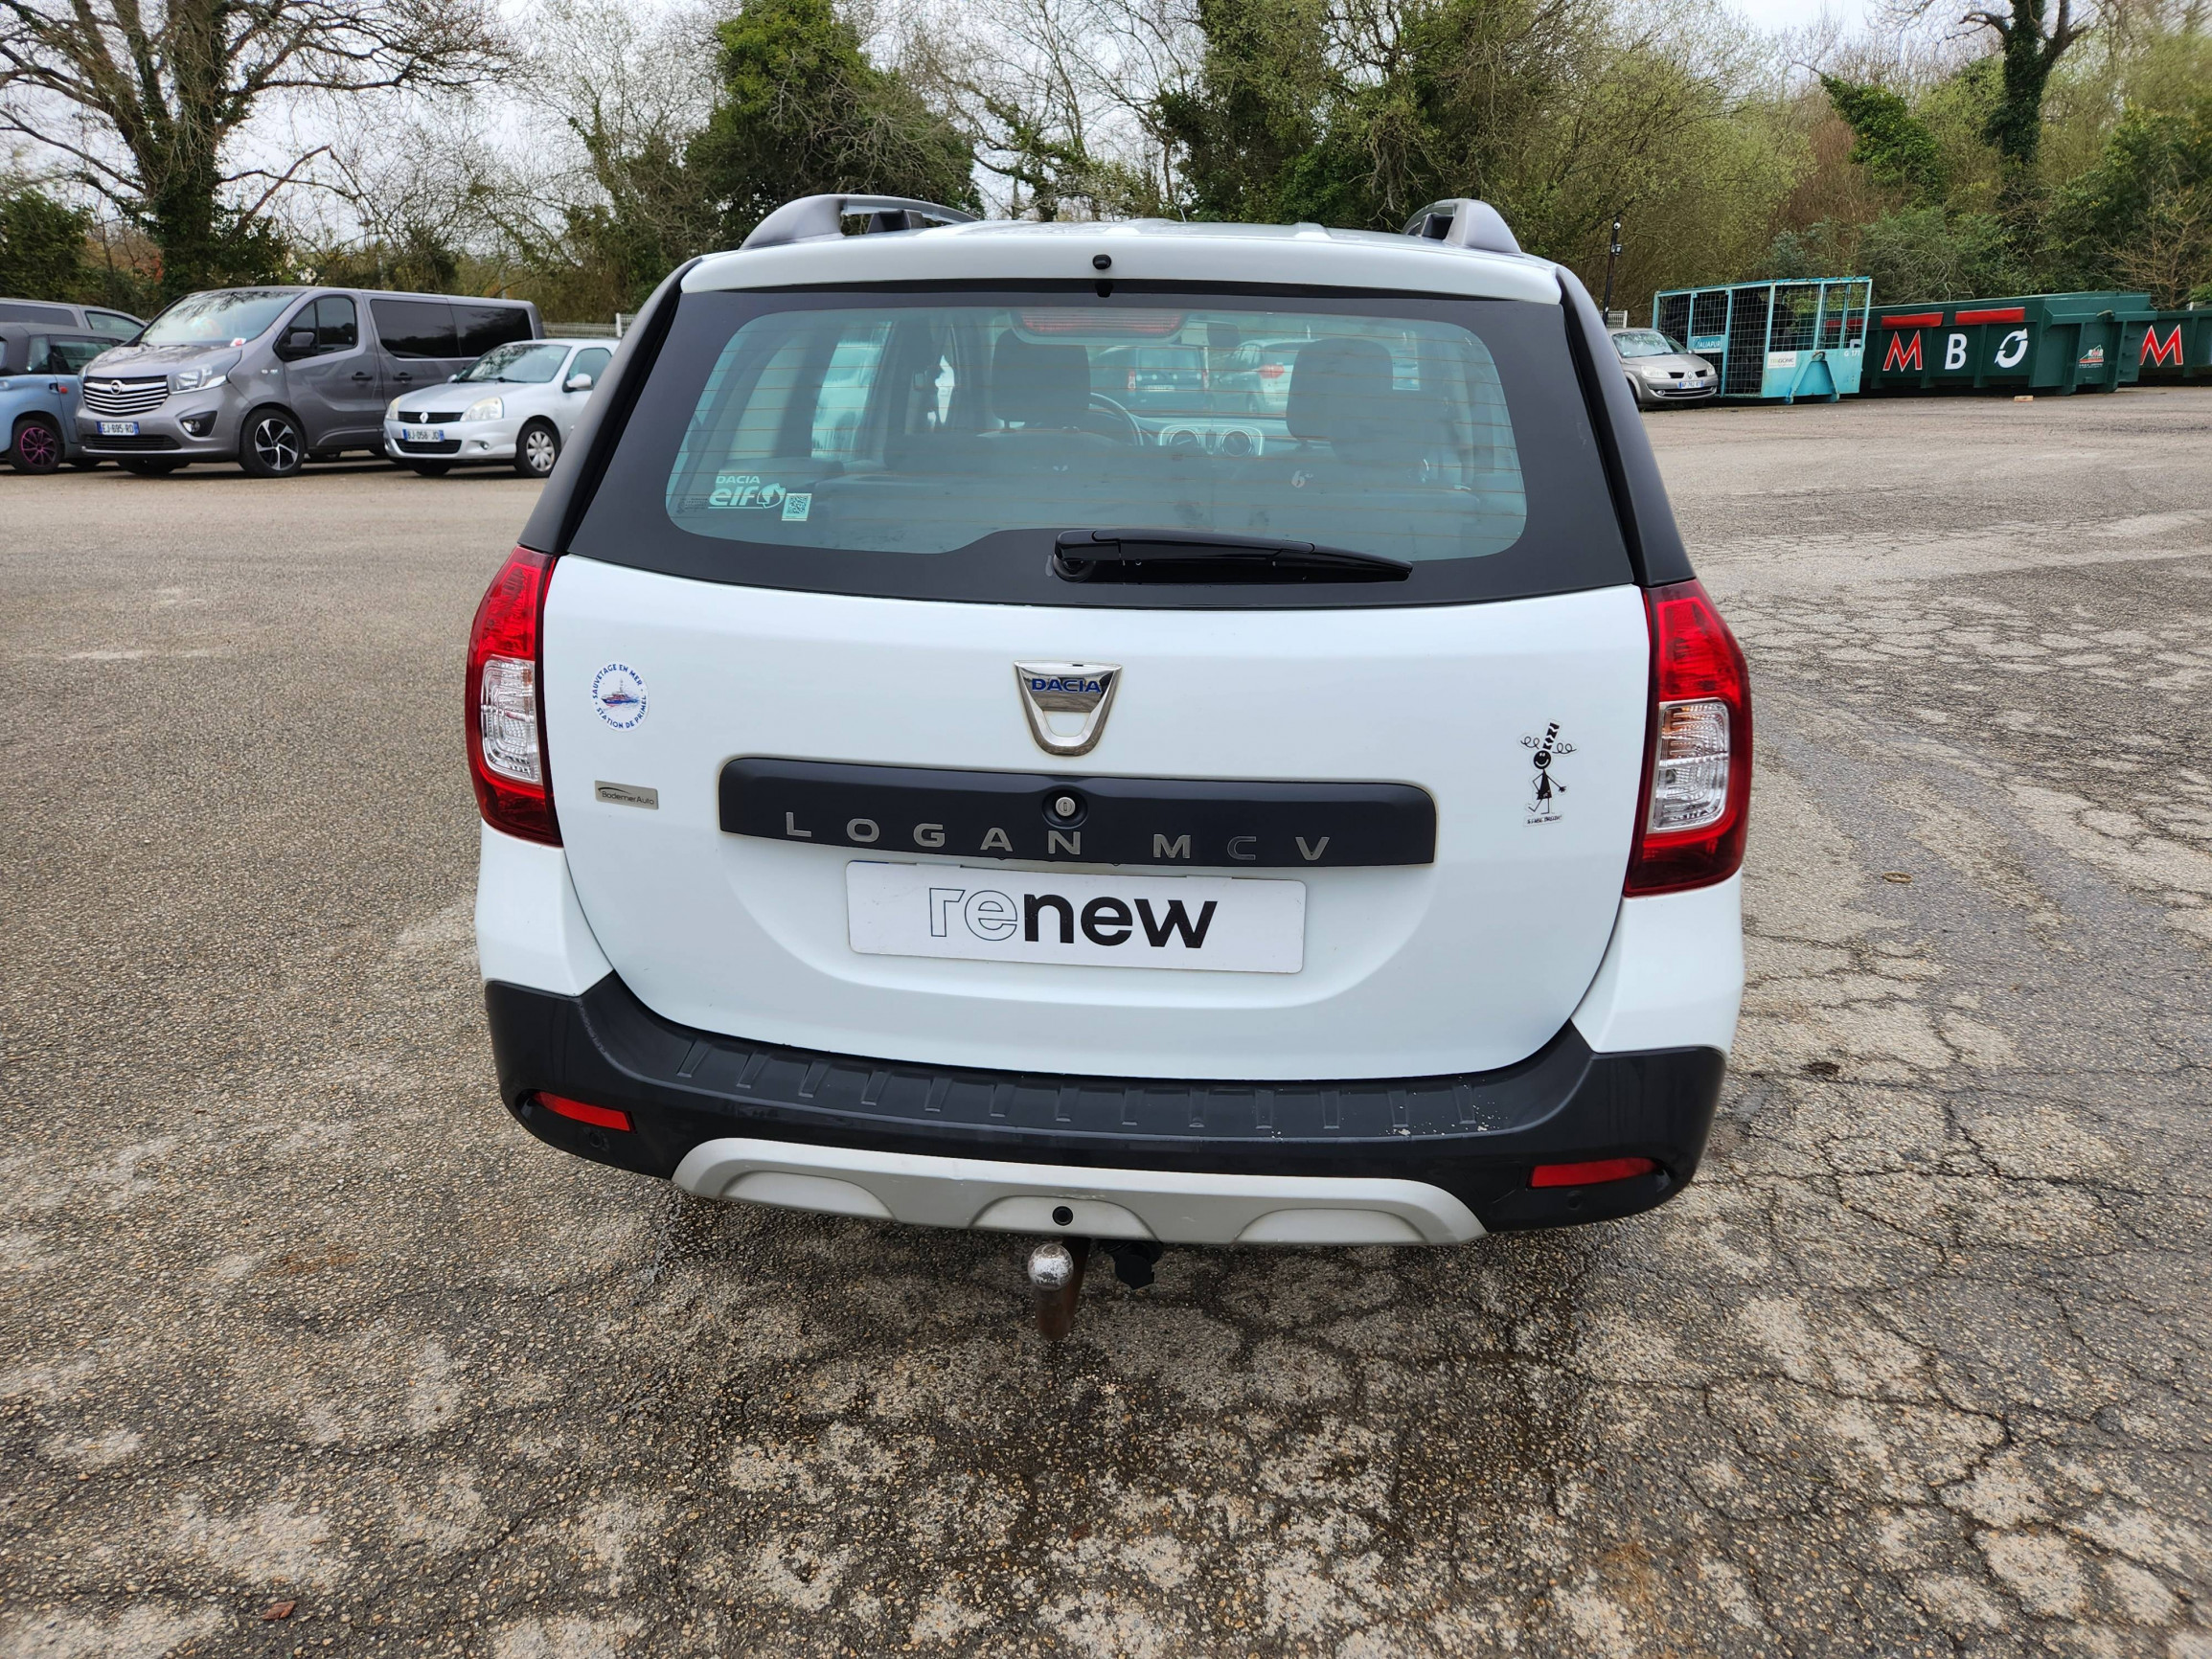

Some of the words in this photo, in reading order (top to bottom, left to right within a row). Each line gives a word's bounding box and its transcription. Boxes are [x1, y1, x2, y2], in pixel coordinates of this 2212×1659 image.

[709, 486, 760, 507] elf
[716, 475, 761, 484] DACIA
[592, 663, 617, 699] SAUVETAGE
[619, 664, 628, 672] EN
[628, 670, 643, 686] MER
[1031, 678, 1102, 693] DACIA
[596, 707, 624, 729] STATION
[626, 720, 635, 729] DE
[635, 695, 647, 723] PRIMEL
[786, 811, 1082, 854] LOGAN
[1152, 833, 1330, 860] MCV
[929, 887, 1219, 949] renew
